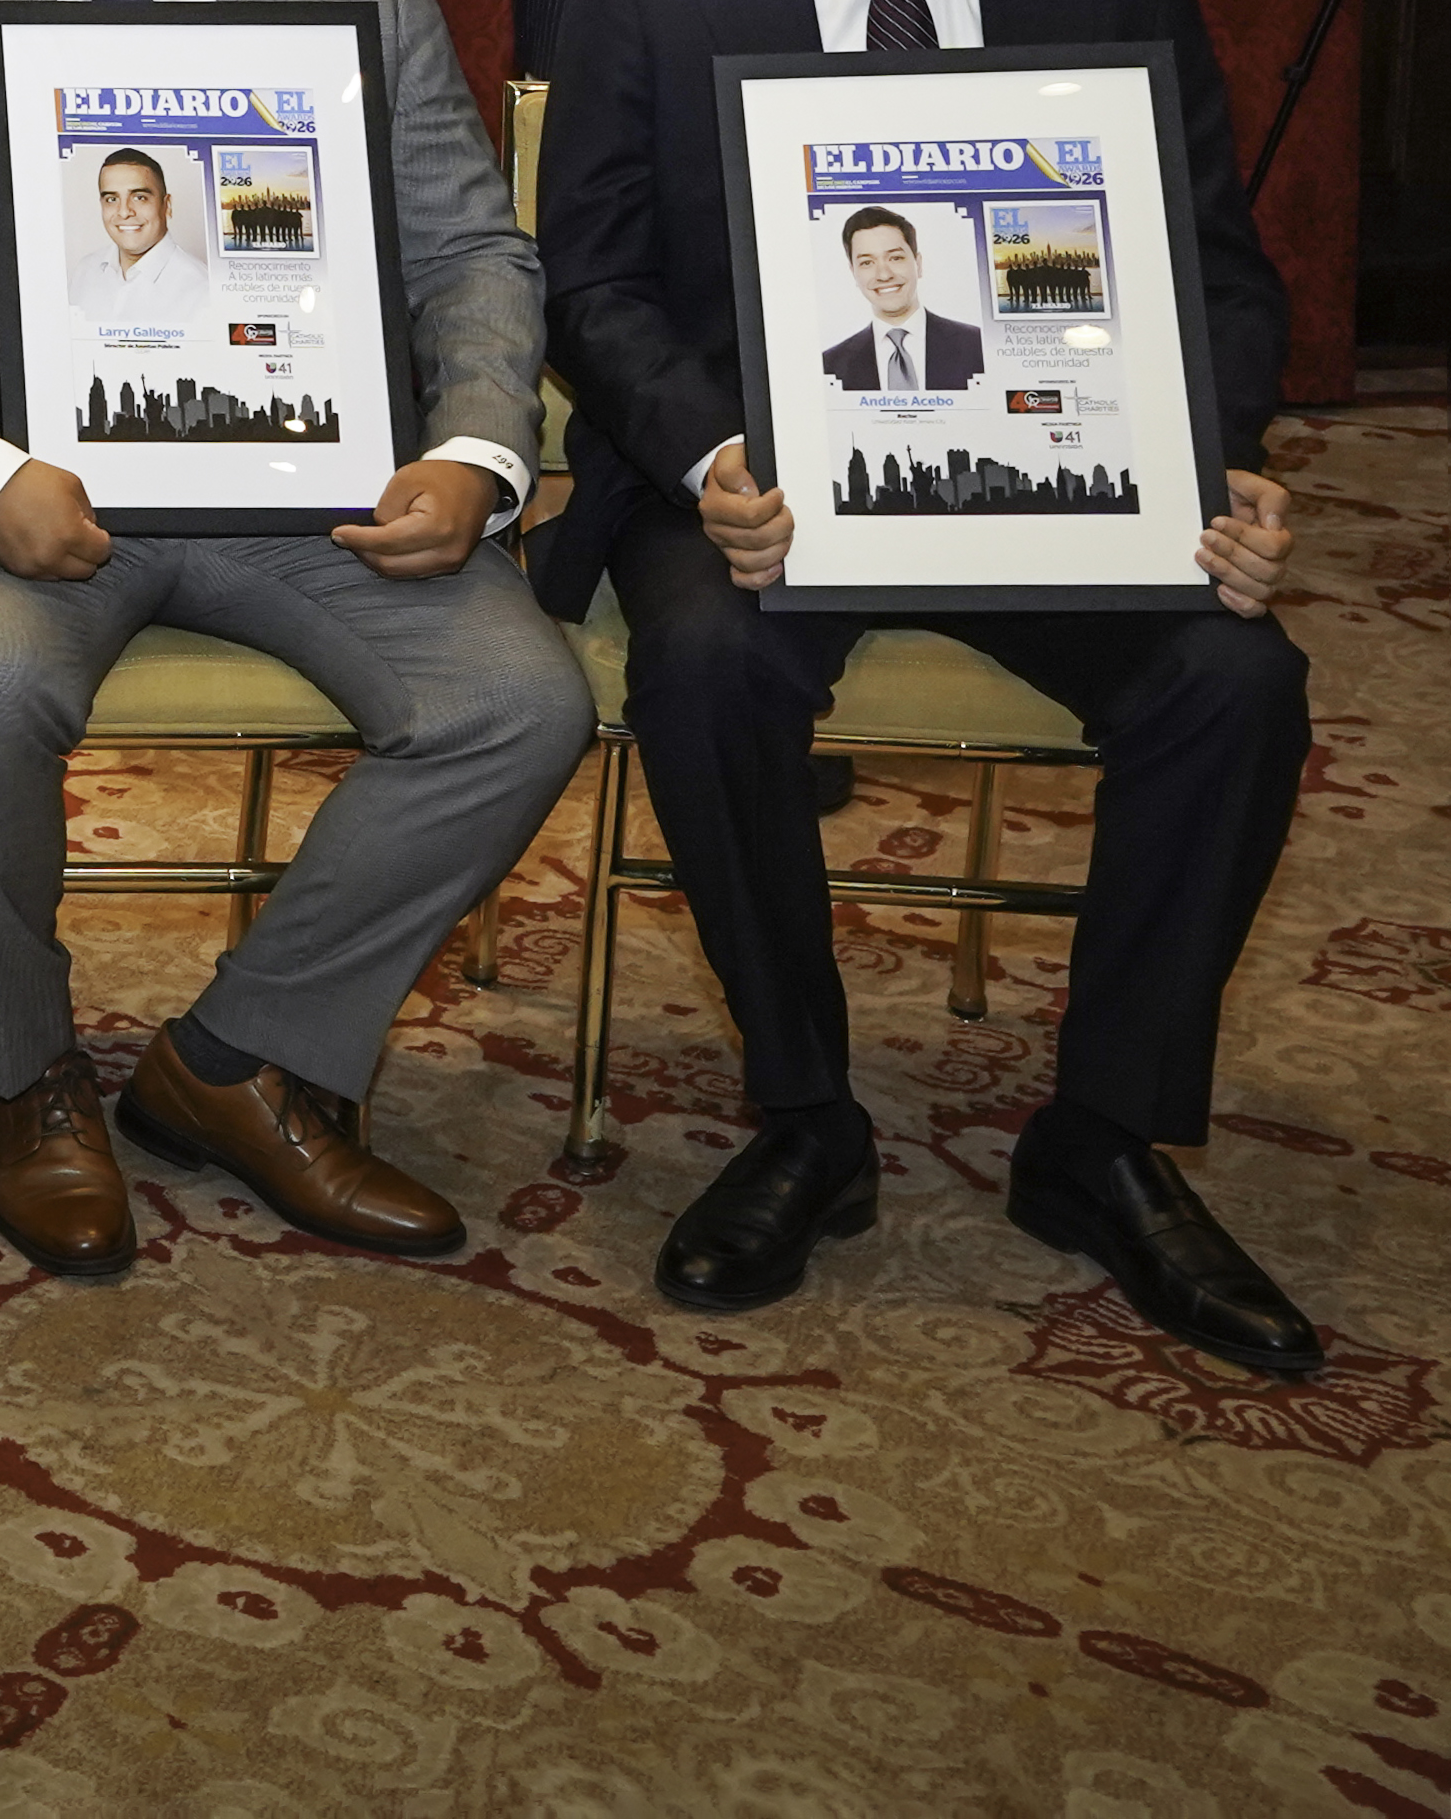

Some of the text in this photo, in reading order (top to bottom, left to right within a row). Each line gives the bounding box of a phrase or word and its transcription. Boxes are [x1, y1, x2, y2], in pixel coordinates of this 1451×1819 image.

[63, 89, 249, 115] EL DIARIO
[272, 89, 312, 111] EL
[813, 140, 1025, 174] EL DIARIO
[1052, 138, 1099, 162] EL
[98, 327, 184, 339] Larry Gallegos
[278, 362, 292, 373] 41
[858, 395, 953, 406] Andrés Acebo
[1064, 430, 1081, 442] 41
